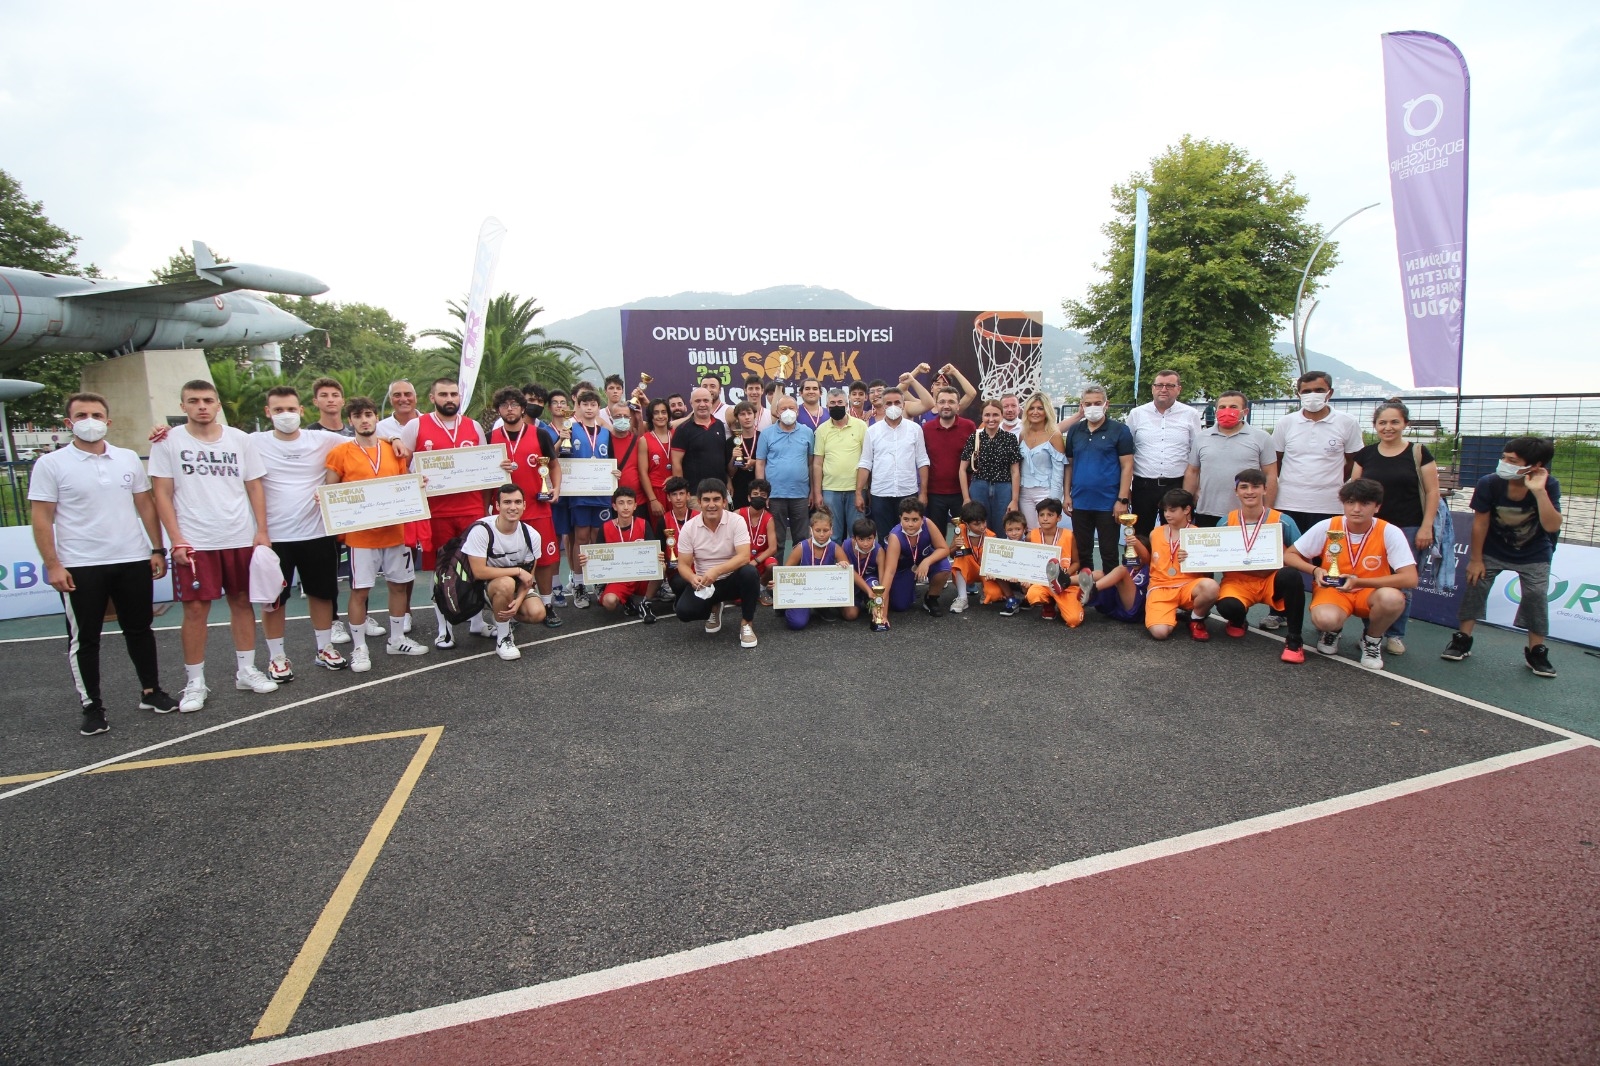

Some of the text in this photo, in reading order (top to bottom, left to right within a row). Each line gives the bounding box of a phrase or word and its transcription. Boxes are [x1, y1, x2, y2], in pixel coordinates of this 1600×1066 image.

[652, 325, 893, 346] ORDU BÜYÜKŞEHİR BELEDİYESİ
[688, 347, 738, 365] ÖDÜLLÜ
[741, 349, 861, 382] SOKAK
[180, 449, 238, 464] CALM
[181, 463, 239, 477] DOWN
[402, 551, 411, 570] 7
